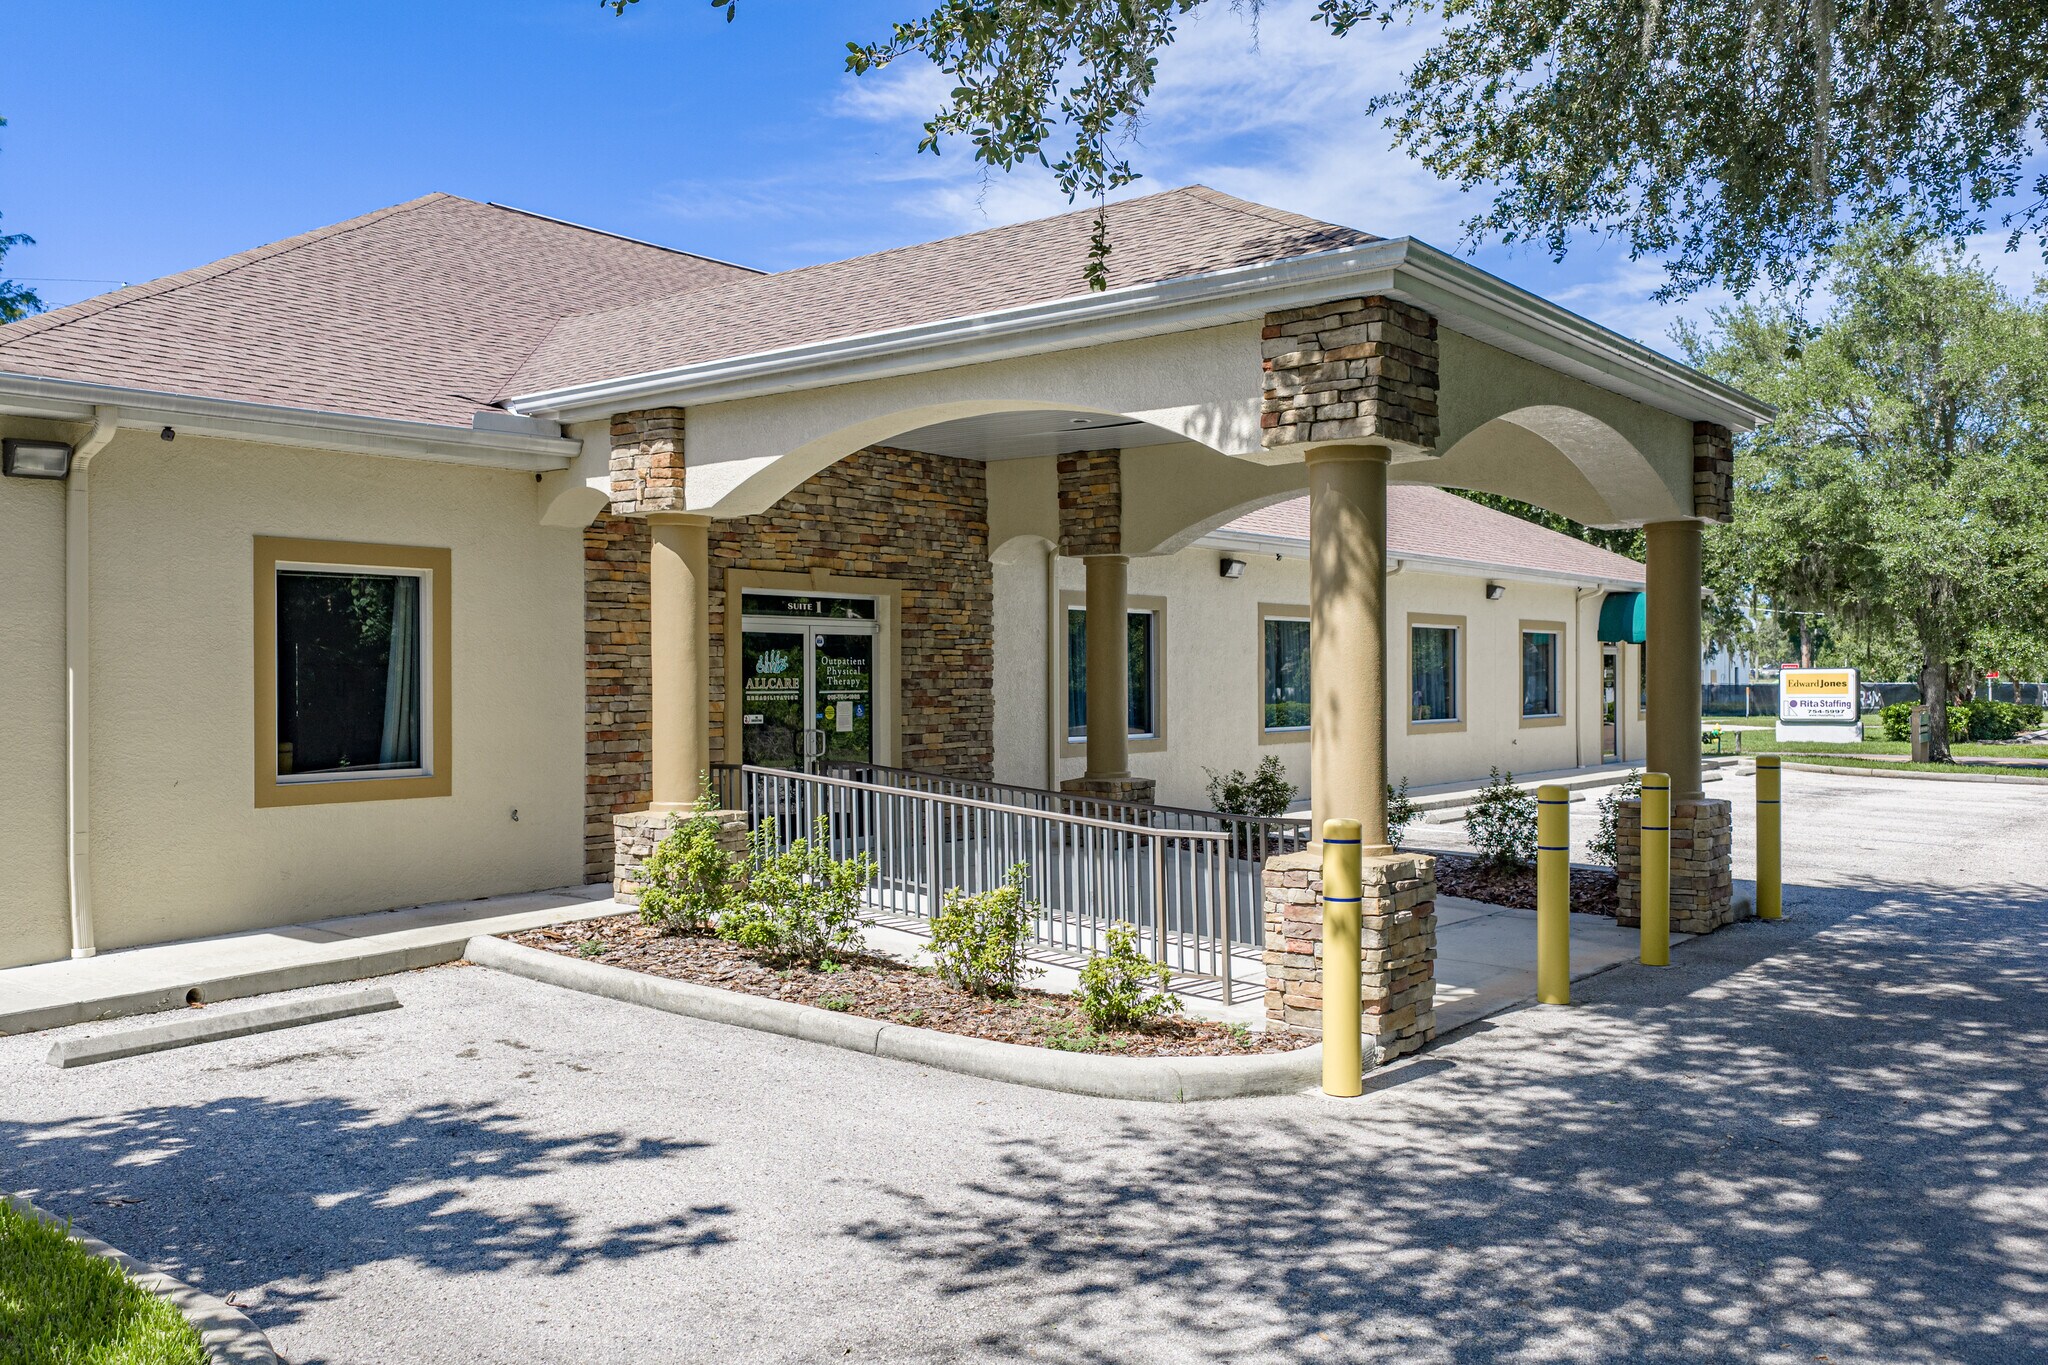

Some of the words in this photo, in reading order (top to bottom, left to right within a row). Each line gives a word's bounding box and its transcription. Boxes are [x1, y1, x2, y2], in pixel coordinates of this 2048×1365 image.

[787, 602, 813, 611] SUITE
[816, 601, 822, 613] 1
[821, 656, 866, 668] Outpatient
[826, 666, 861, 678] Physical
[745, 677, 800, 690] ALLCARE
[826, 676, 861, 688] Therapy
[1788, 679, 1820, 688] Edward
[1820, 679, 1847, 688] Jones
[1800, 700, 1819, 708] Rita
[1820, 700, 1852, 710] Staffing
